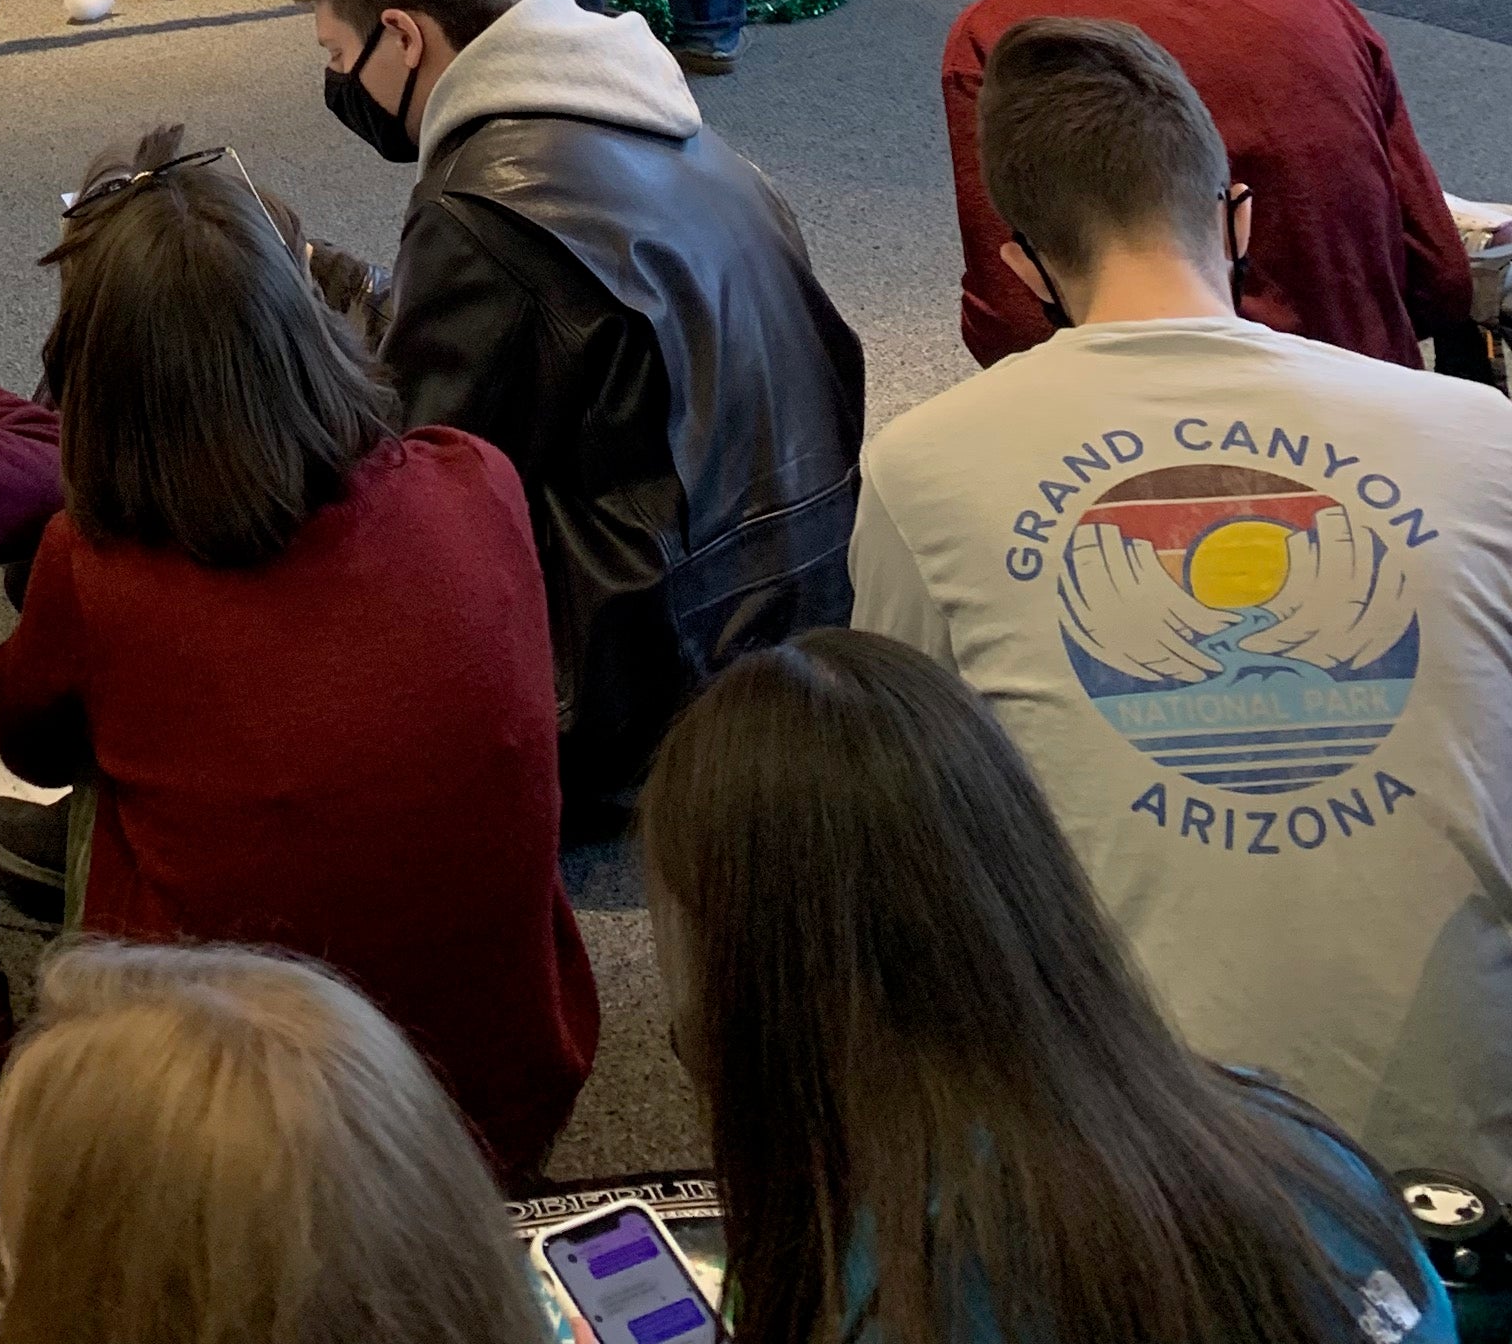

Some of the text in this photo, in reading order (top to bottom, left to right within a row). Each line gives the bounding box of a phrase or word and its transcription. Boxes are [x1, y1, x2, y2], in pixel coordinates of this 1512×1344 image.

[1006, 417, 1440, 582] GRAND CANYON
[1117, 685, 1391, 728] NATIONAL PARK
[1129, 768, 1418, 855] ARIZONA
